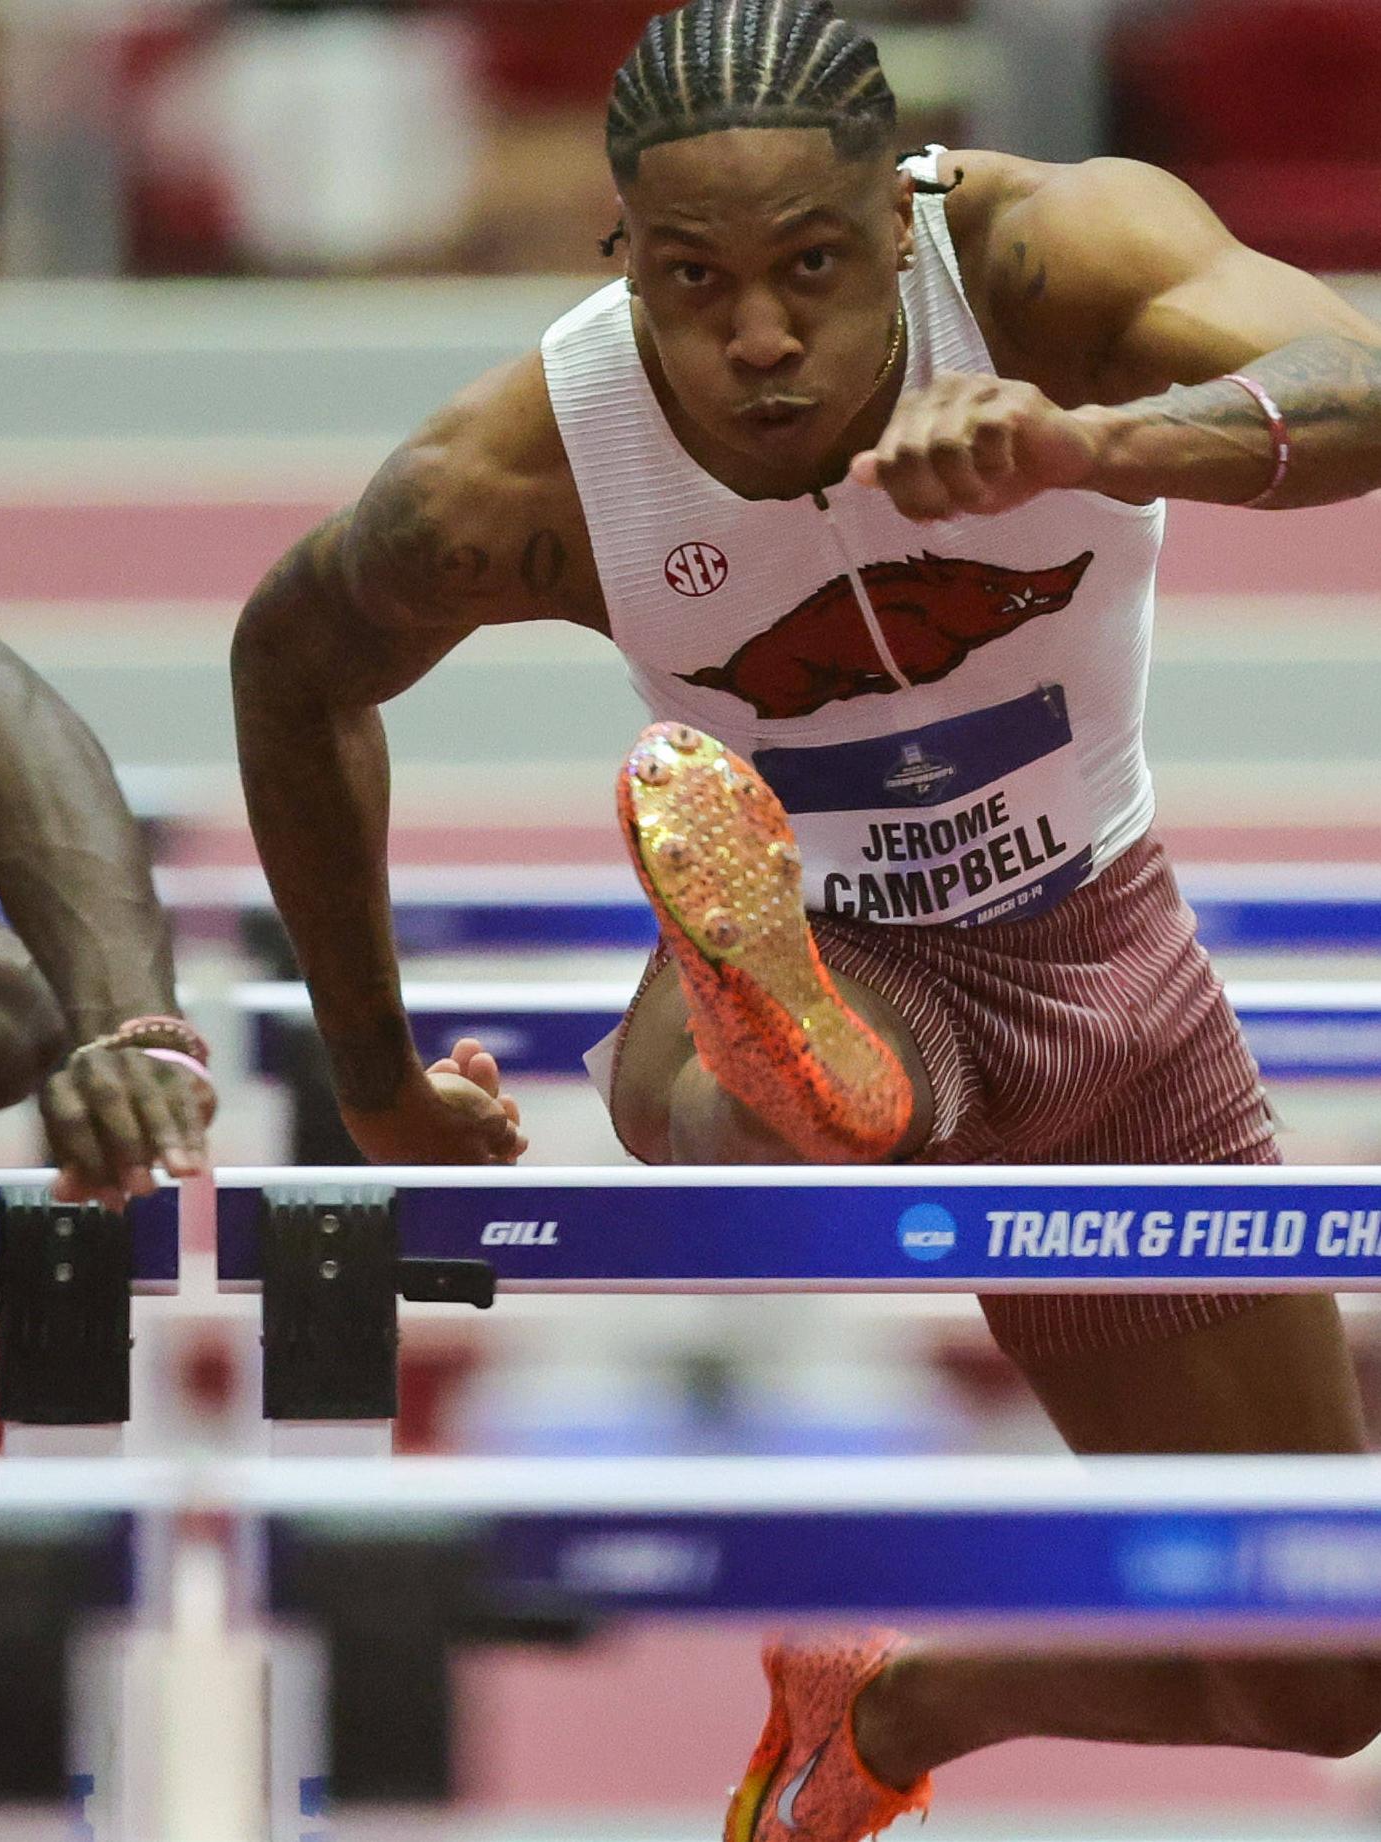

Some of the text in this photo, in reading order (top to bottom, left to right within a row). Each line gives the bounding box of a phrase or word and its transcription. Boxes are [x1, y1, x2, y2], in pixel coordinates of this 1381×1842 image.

[666, 543, 727, 595] SEC
[861, 791, 1011, 863] JEROME
[824, 814, 1067, 919] CAMPBELL
[480, 1221, 559, 1245] GILL
[902, 1231, 955, 1248] NCAA
[985, 1210, 1381, 1257] TRACK & FIELD CH
